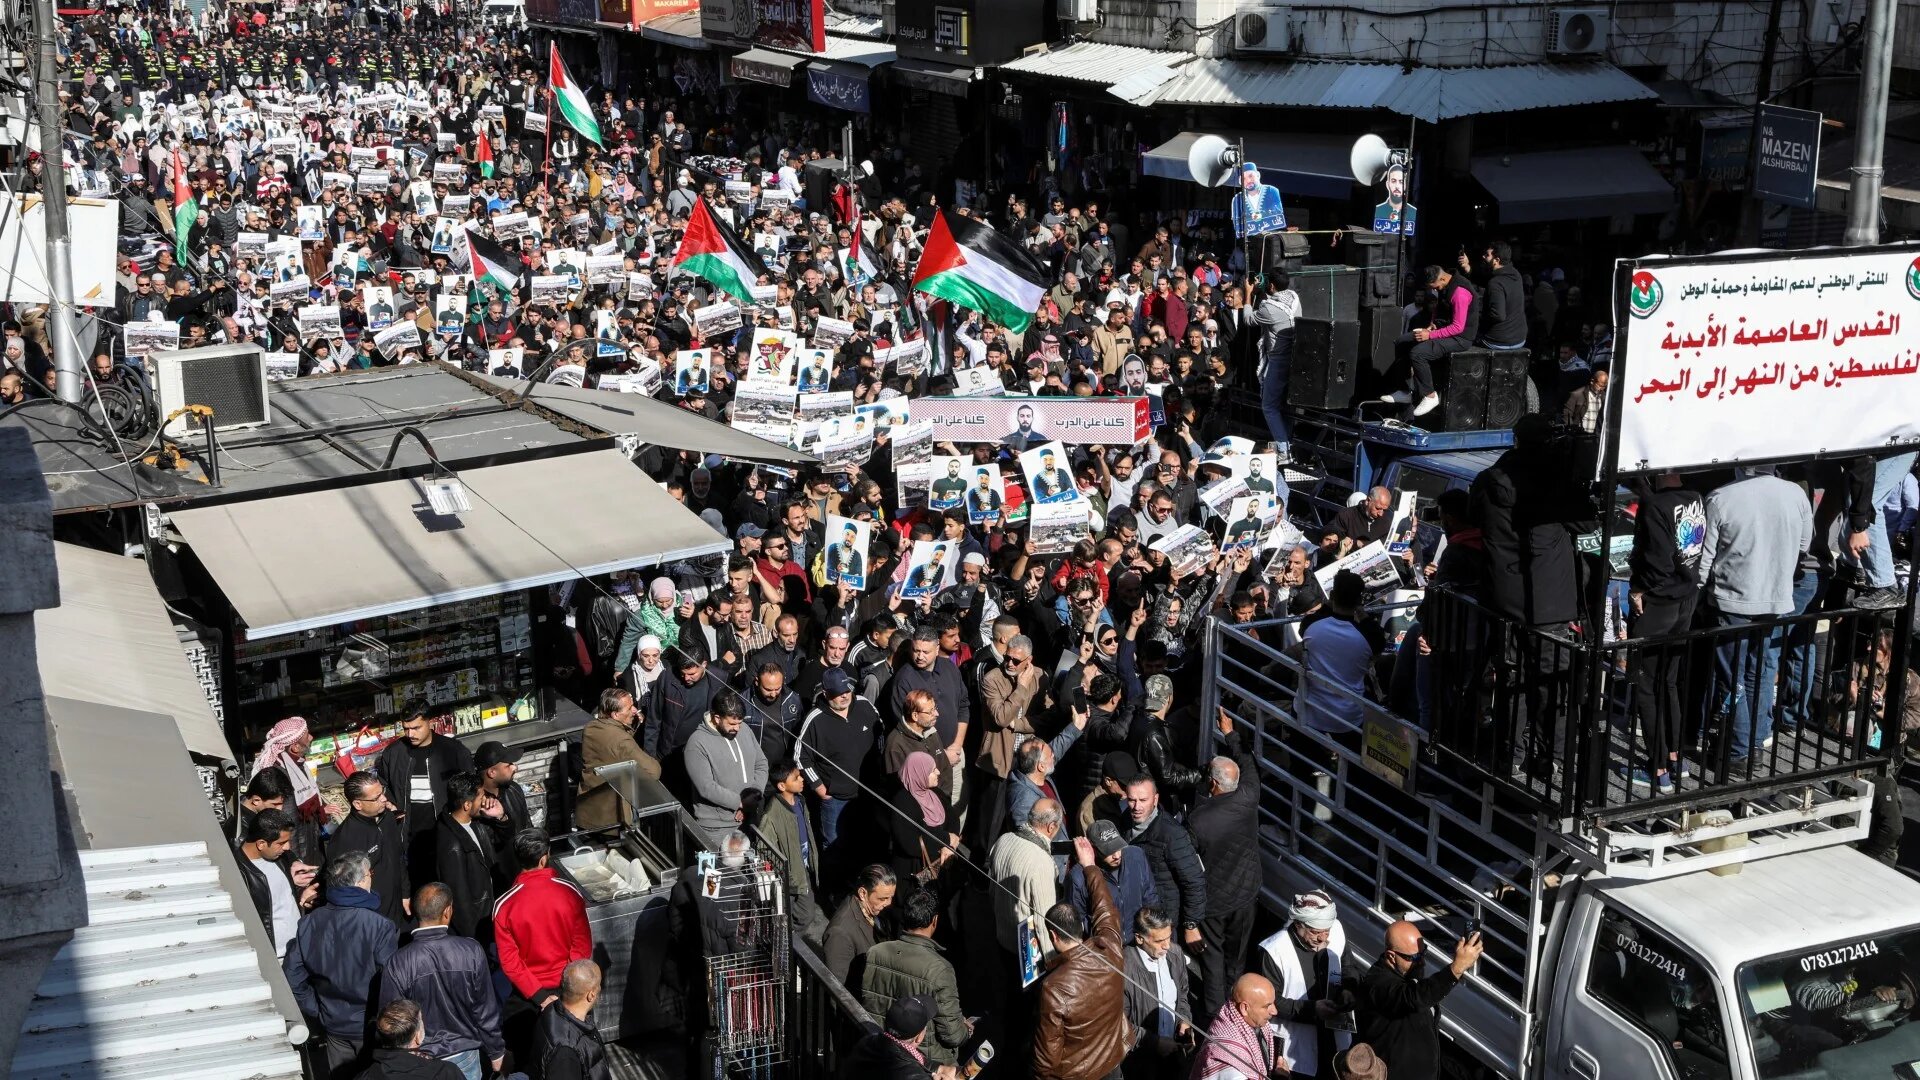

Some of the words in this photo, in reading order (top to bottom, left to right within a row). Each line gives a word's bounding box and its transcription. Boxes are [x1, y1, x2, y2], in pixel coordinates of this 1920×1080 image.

[1761, 137, 1811, 161] MAZEN
[1761, 156, 1808, 172] ALSHURBAJI
[1680, 280, 1708, 300] الوطن
[1750, 276, 1787, 295] المقاومة
[1789, 276, 1815, 293] لدعم
[1817, 274, 1854, 298] الوطني
[1856, 271, 1888, 287] الملتقى
[1661, 313, 1727, 358] الأبدية
[1733, 316, 1828, 347] العاصمة
[1833, 310, 1900, 346] القدس
[1634, 367, 1691, 403] البحر
[1696, 366, 1727, 401] إلى
[1730, 361, 1785, 395] النهر
[1789, 364, 1818, 390] من
[945, 414, 962, 426] على
[963, 415, 985, 426] كلنا
[1056, 417, 1083, 428] الدرب
[1084, 416, 1099, 430] على
[1100, 417, 1125, 428] كلنا
[1616, 933, 1686, 981] 0781272414
[1800, 940, 1879, 973] 0781272414
